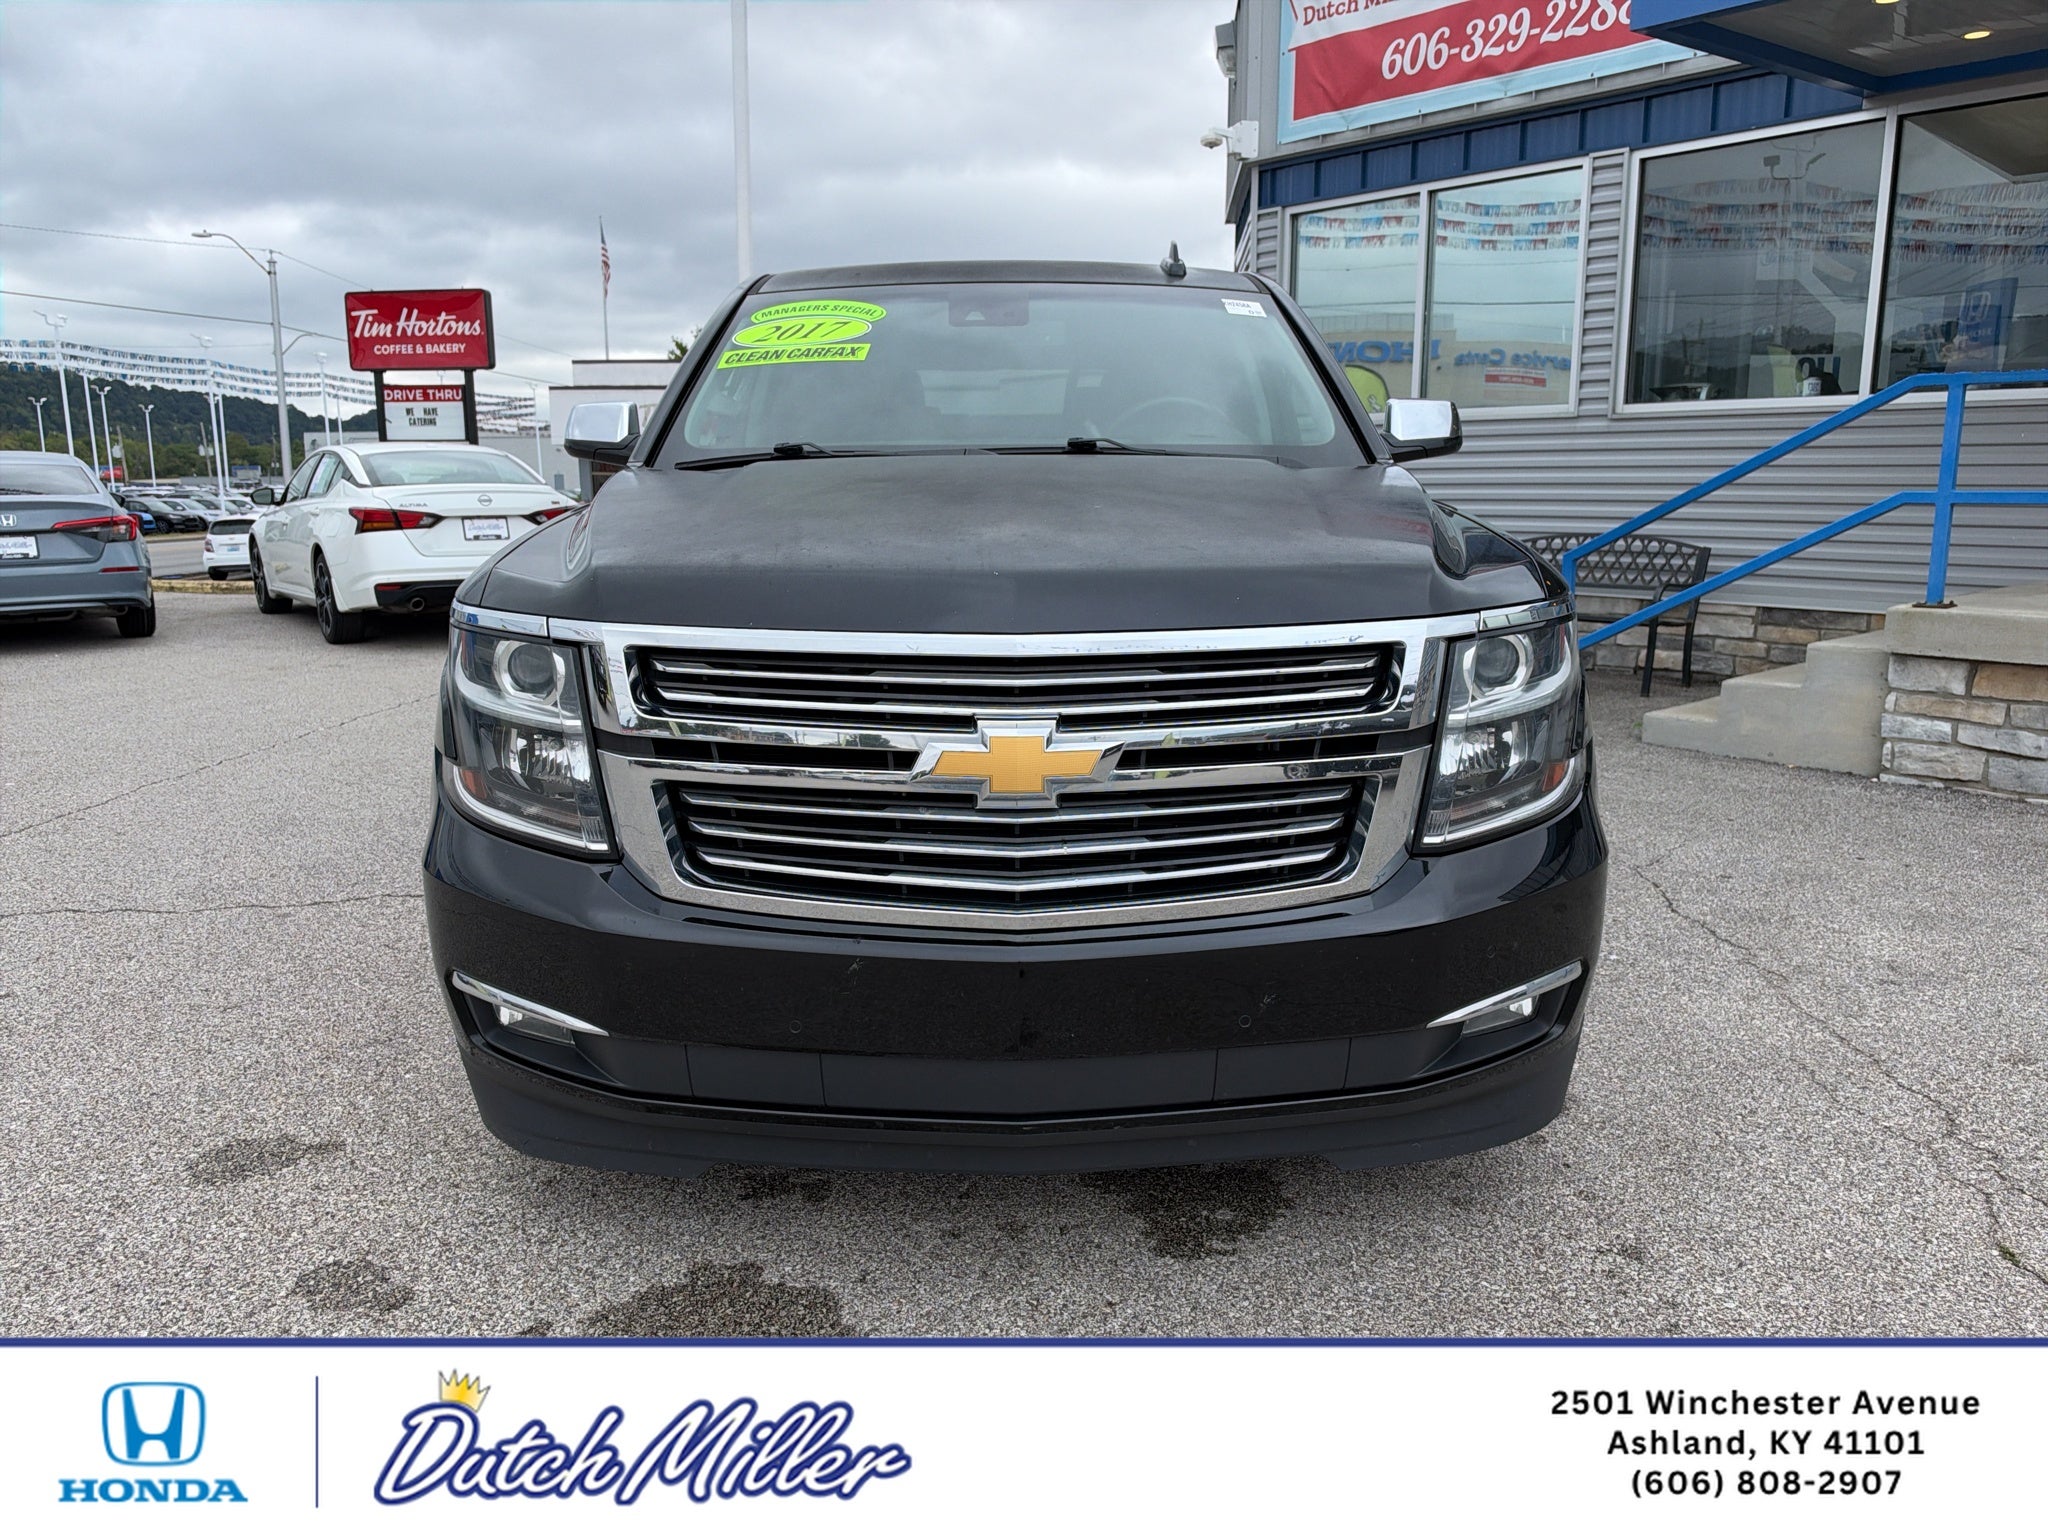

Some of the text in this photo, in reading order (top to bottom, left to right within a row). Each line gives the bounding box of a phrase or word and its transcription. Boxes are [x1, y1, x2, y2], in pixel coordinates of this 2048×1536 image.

[1302, 0, 1359, 26] Dutch
[761, 304, 877, 319] MANAGERS SPECIAL
[351, 307, 481, 338] Tim Hortons
[752, 321, 851, 343] 2017
[374, 343, 466, 355] COFFEE & BAKERY
[724, 346, 864, 365] CLEAN CARFAX
[384, 389, 462, 400] DRIVE THRU
[405, 407, 439, 416] WE HAVE
[408, 417, 437, 426] CATERING
